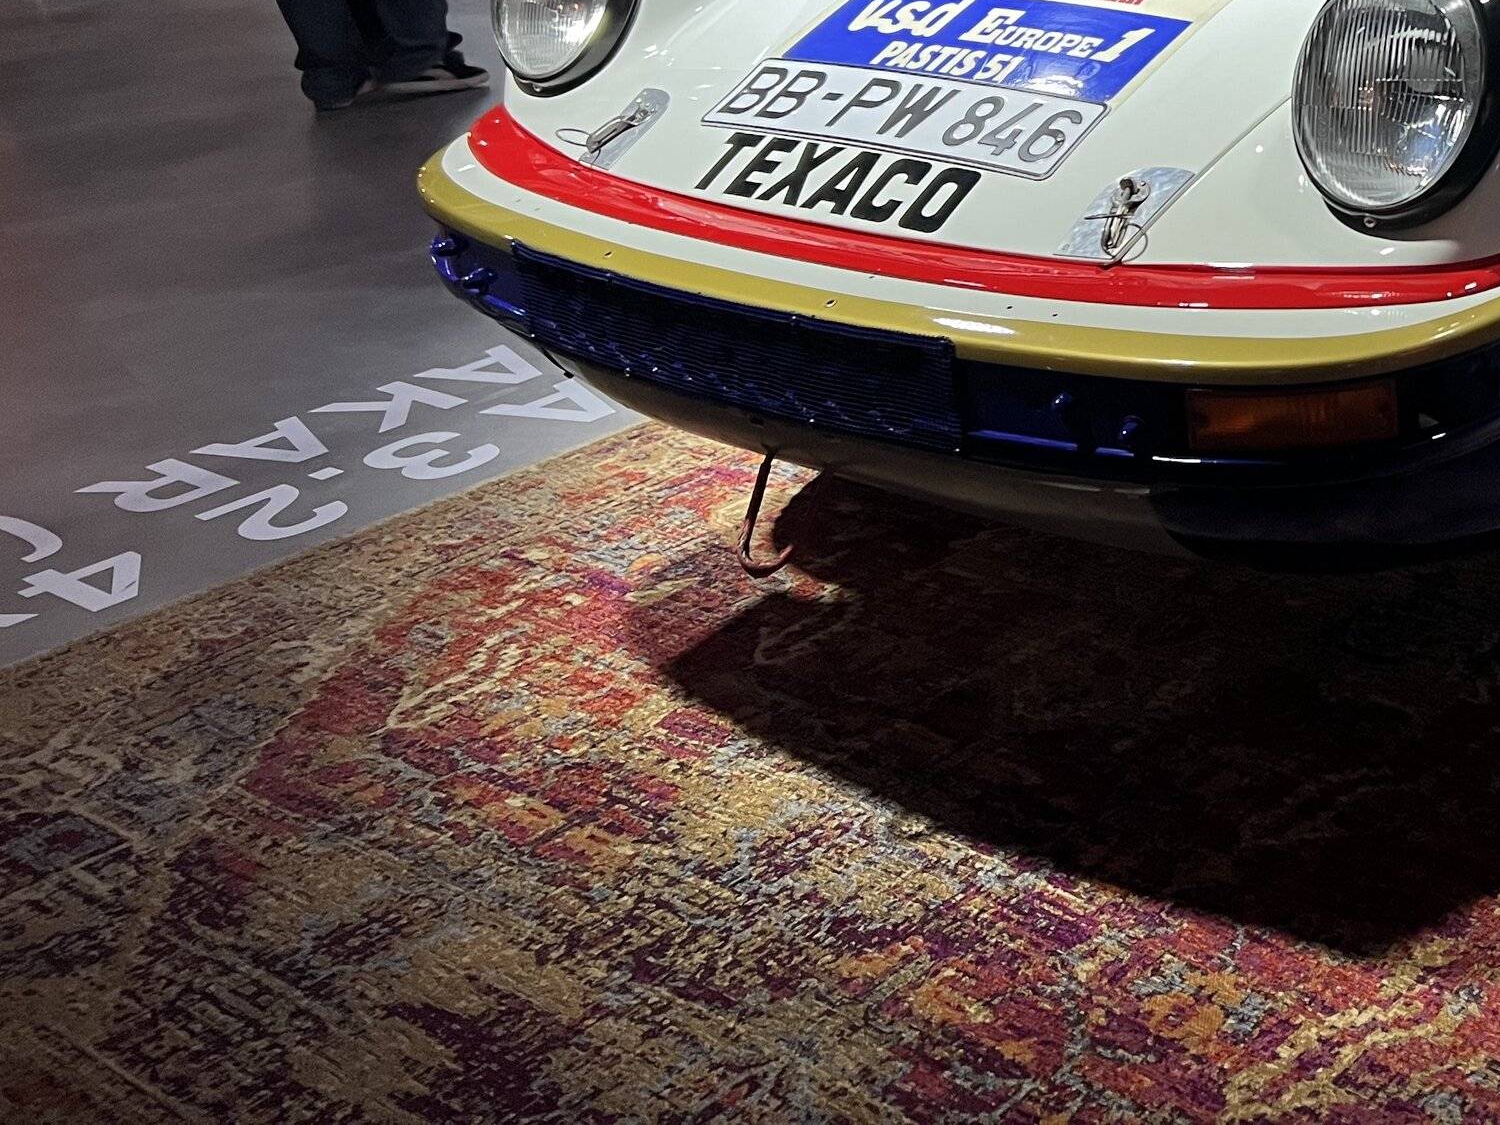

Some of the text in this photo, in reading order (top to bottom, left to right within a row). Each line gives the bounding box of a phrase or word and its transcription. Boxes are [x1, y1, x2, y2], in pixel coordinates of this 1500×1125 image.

[868, 40, 1026, 84] PASTIS 51
[1097, 27, 1156, 64] 1
[716, 66, 1084, 164] BB-PW 846
[694, 132, 983, 235] TEXACO
[73, 344, 543, 513] AKAR
